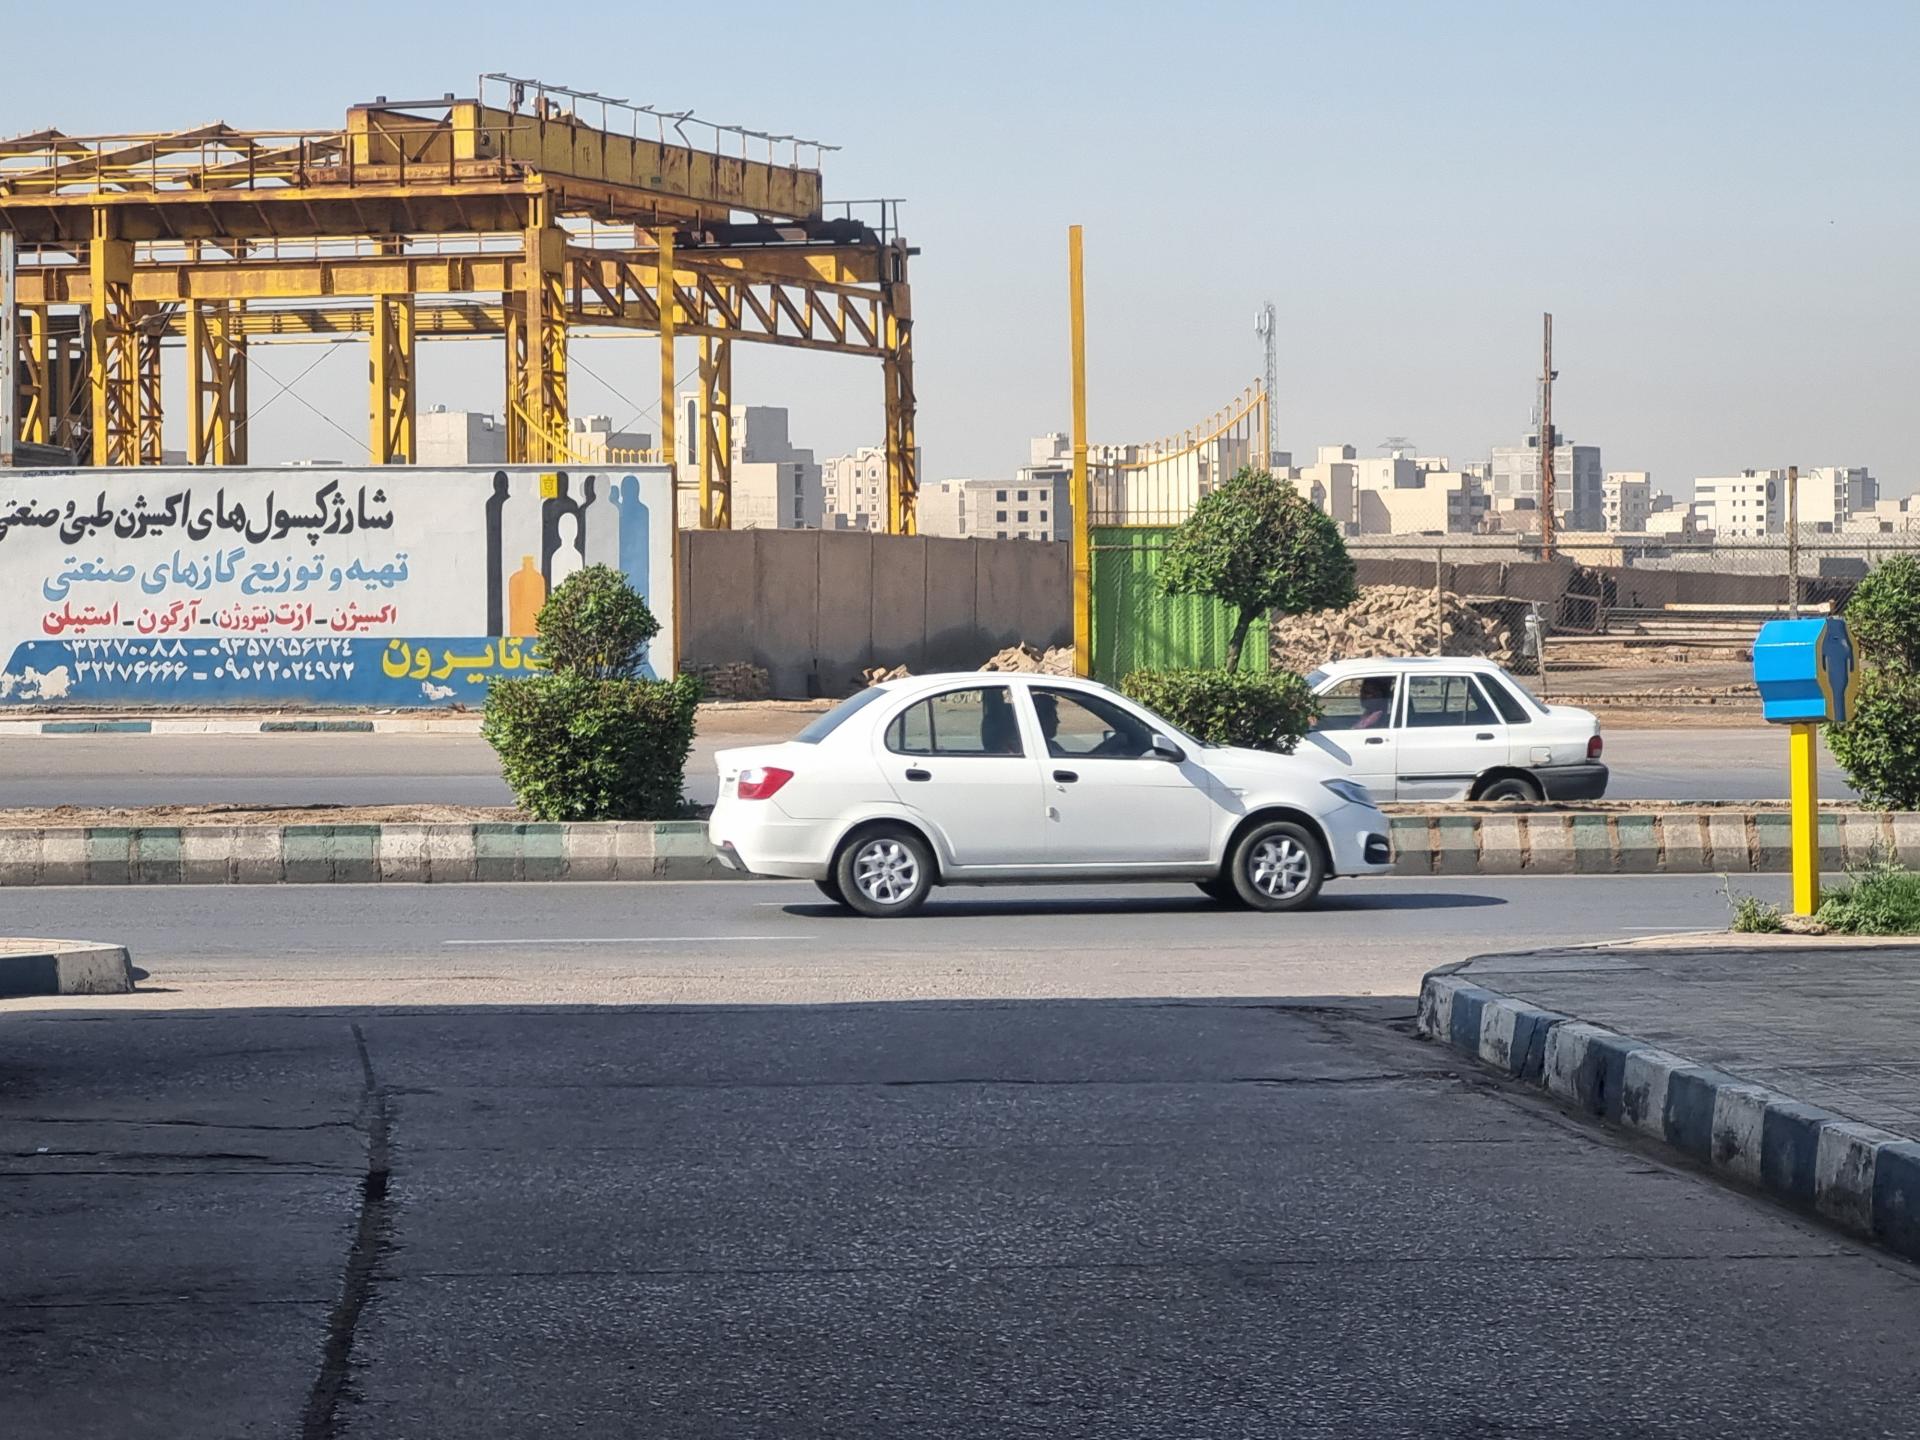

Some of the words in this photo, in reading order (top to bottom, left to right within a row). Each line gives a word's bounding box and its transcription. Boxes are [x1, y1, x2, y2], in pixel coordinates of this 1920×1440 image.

[60, 490, 114, 545] طبی
[114, 488, 191, 539] اکسیژن
[43, 556, 136, 601] صنعتی
[241, 554, 325, 595] توزیع
[328, 567, 342, 591] و
[346, 553, 408, 590] تهیه
[43, 601, 119, 635] استیلن
[137, 599, 202, 634] آرگون
[331, 602, 397, 631] اکسیژن
